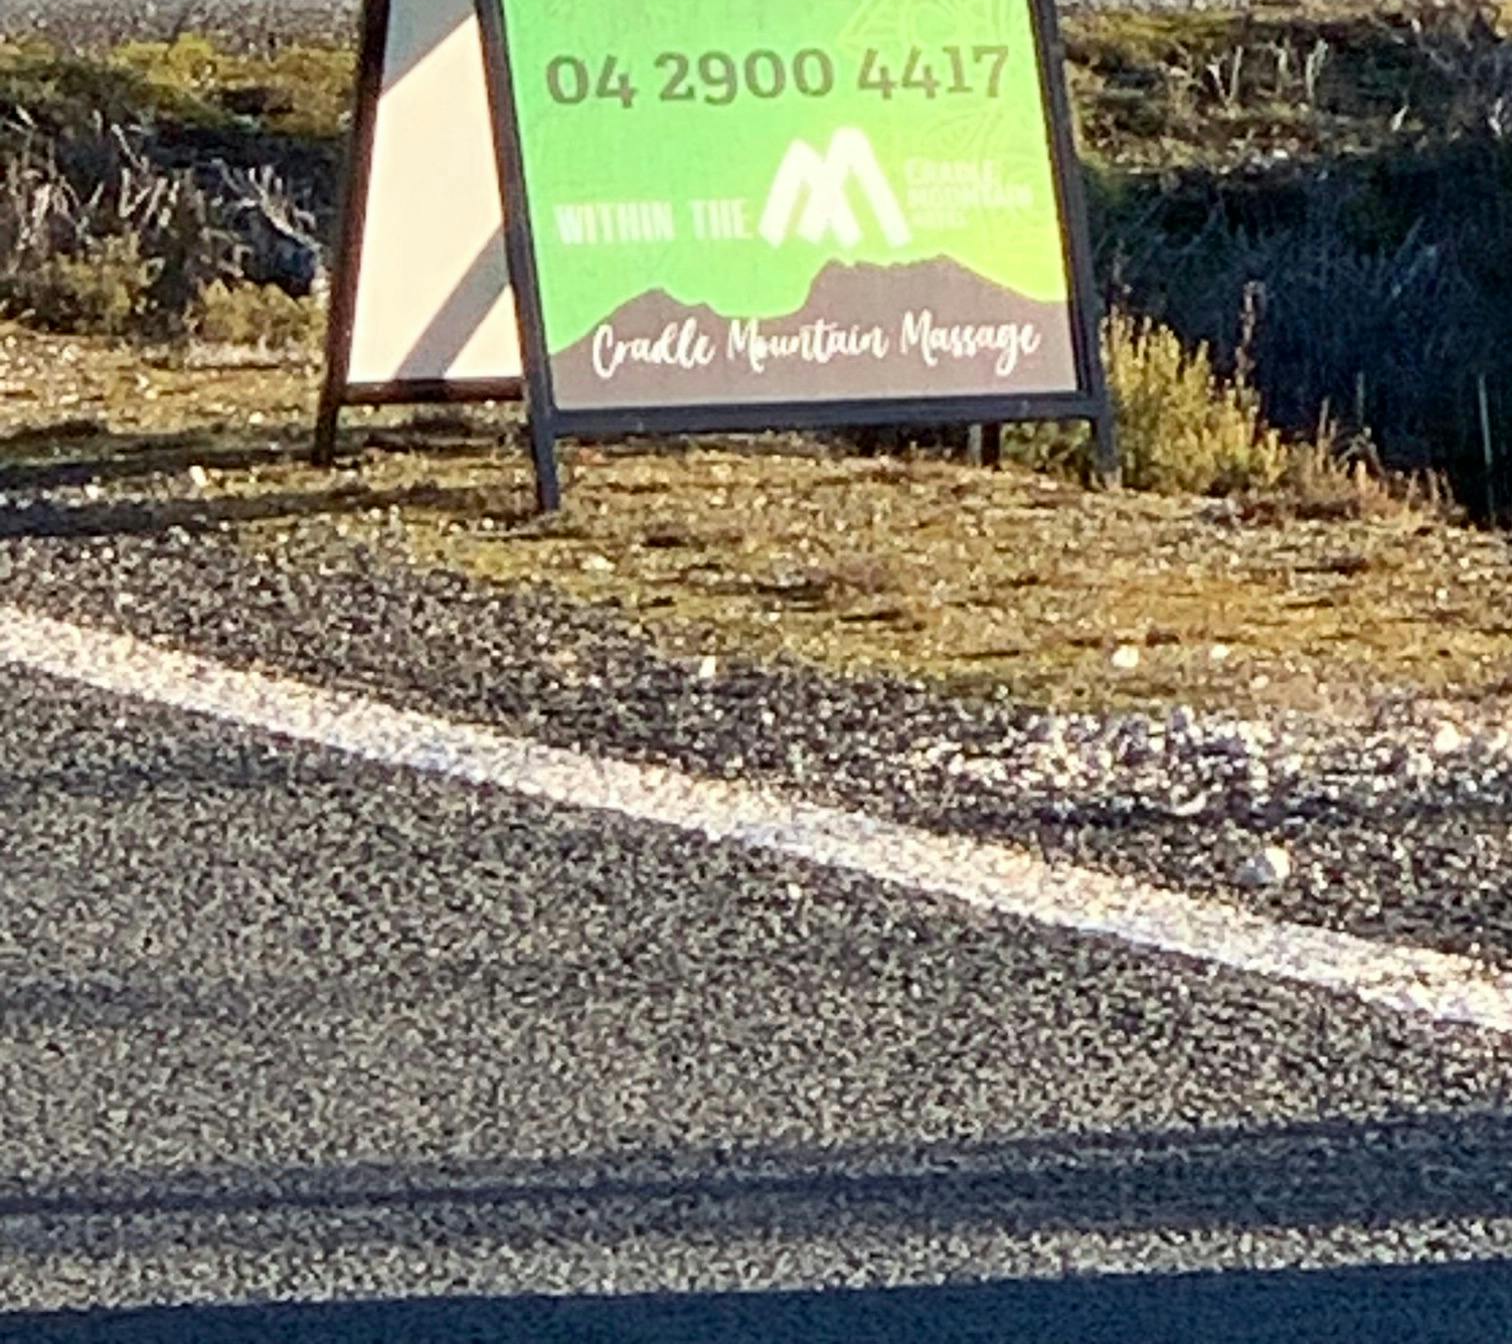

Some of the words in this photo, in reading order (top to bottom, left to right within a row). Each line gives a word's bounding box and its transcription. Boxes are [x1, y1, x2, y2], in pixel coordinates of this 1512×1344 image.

[545, 53, 638, 110] 04
[652, 47, 835, 107] 2900
[856, 44, 1010, 101] 4417
[554, 200, 676, 246] WITHIN
[687, 197, 754, 242] THE
[591, 315, 716, 380] Cradle
[725, 318, 889, 374] Mountain
[899, 308, 1043, 378] Massage
